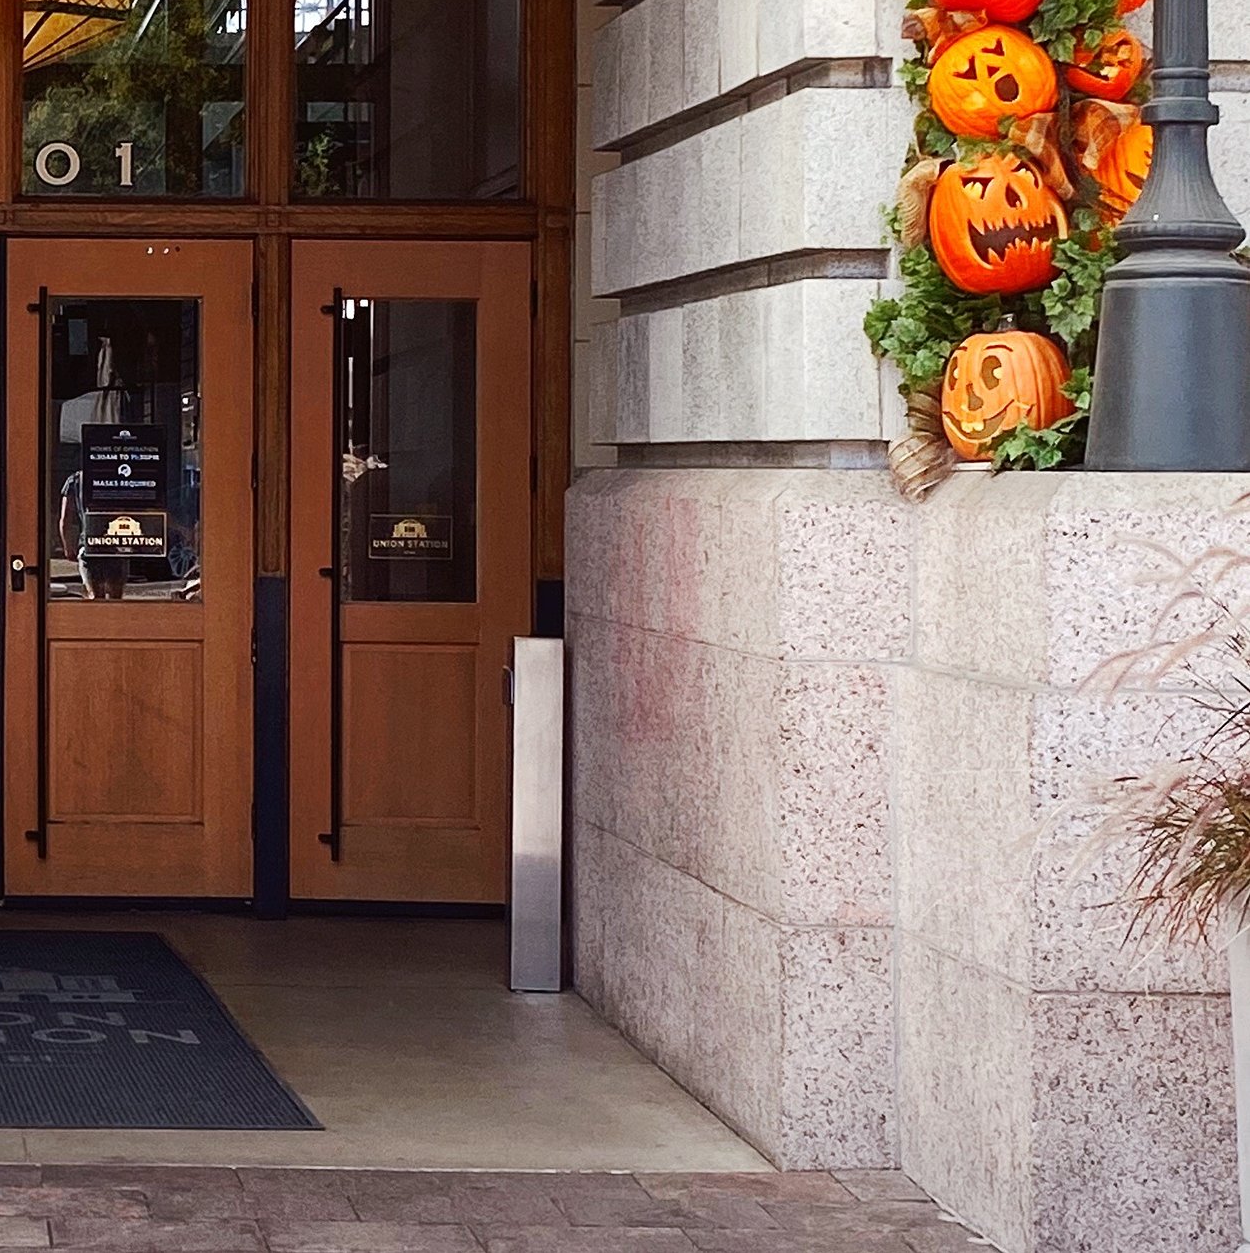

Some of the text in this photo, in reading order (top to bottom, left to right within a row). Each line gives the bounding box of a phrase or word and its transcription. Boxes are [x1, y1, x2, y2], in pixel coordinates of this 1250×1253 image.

[88, 537, 163, 546] UNION STATION
[373, 540, 448, 548] UNION STATION
